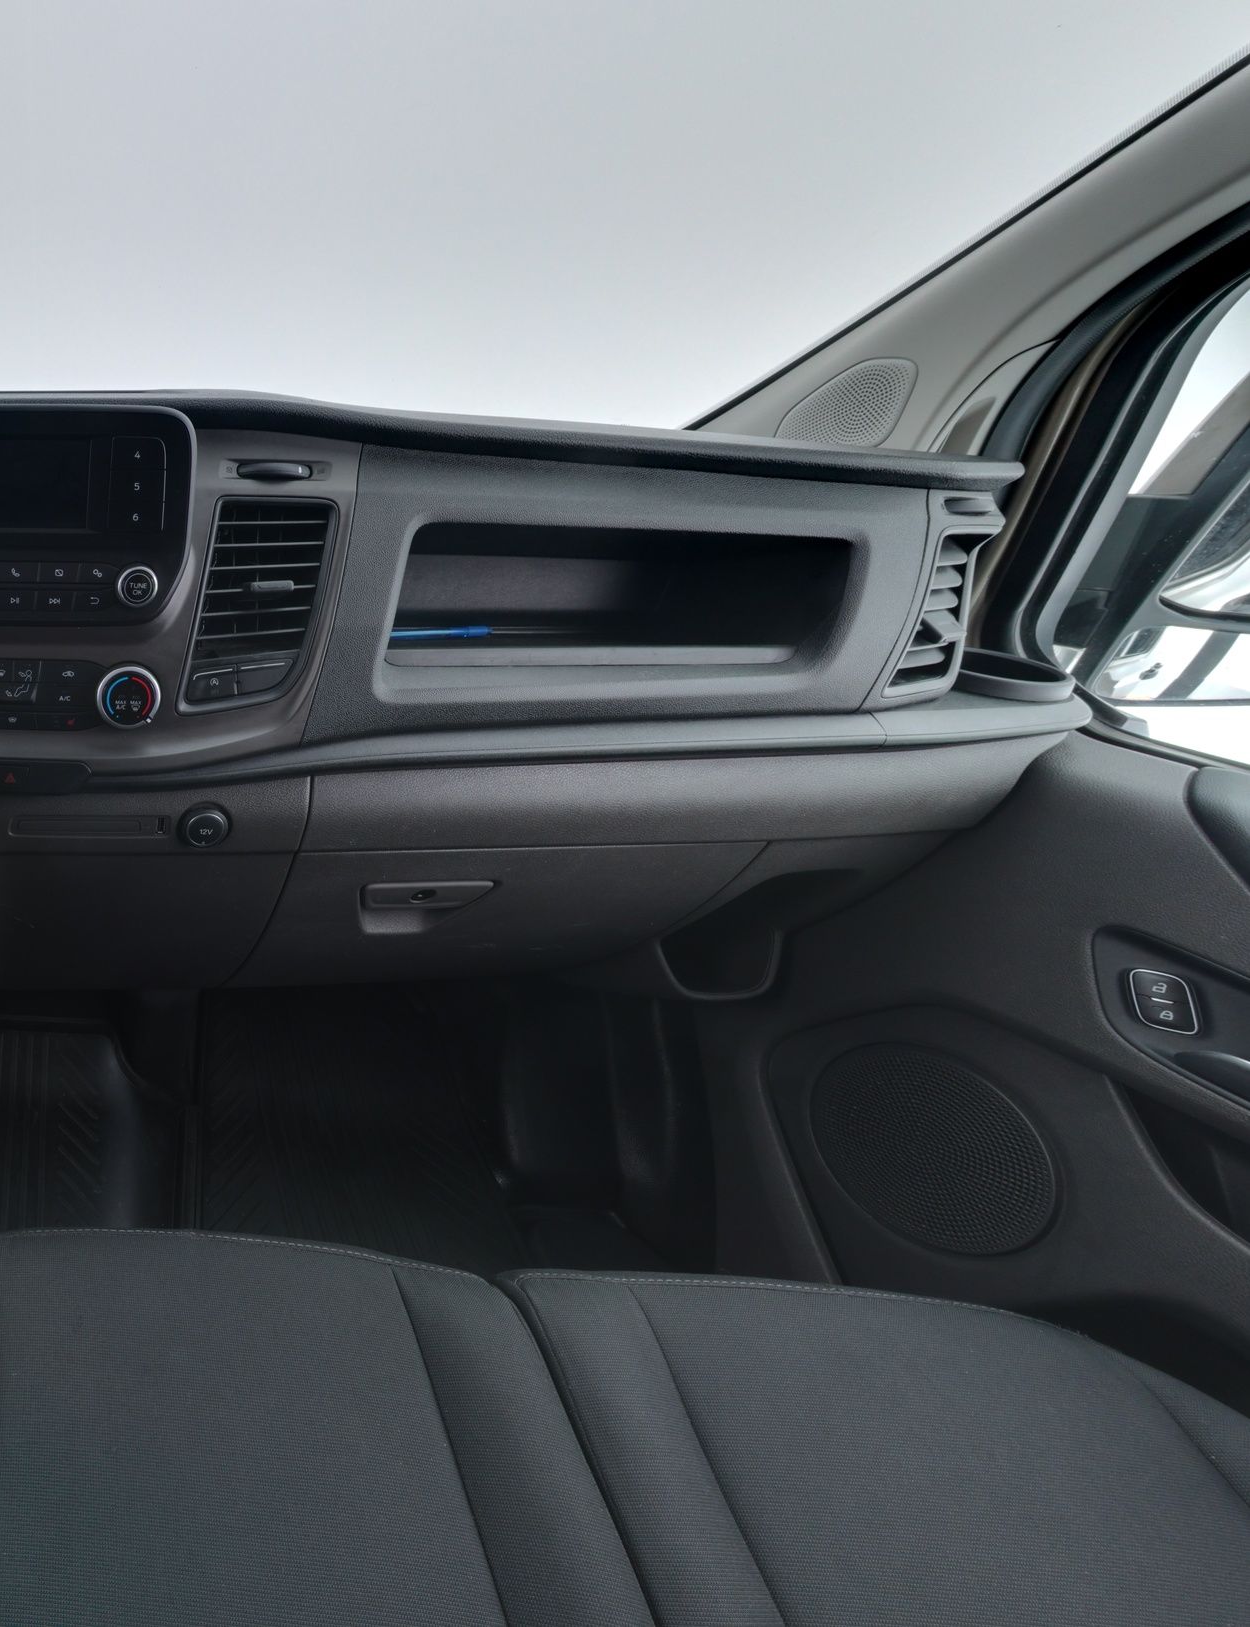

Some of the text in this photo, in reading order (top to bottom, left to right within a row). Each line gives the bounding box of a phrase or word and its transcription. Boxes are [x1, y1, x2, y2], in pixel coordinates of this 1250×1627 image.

[134, 450, 141, 459] 4
[134, 482, 140, 491] 5
[132, 513, 139, 522] 6
[199, 828, 214, 836] 12V
